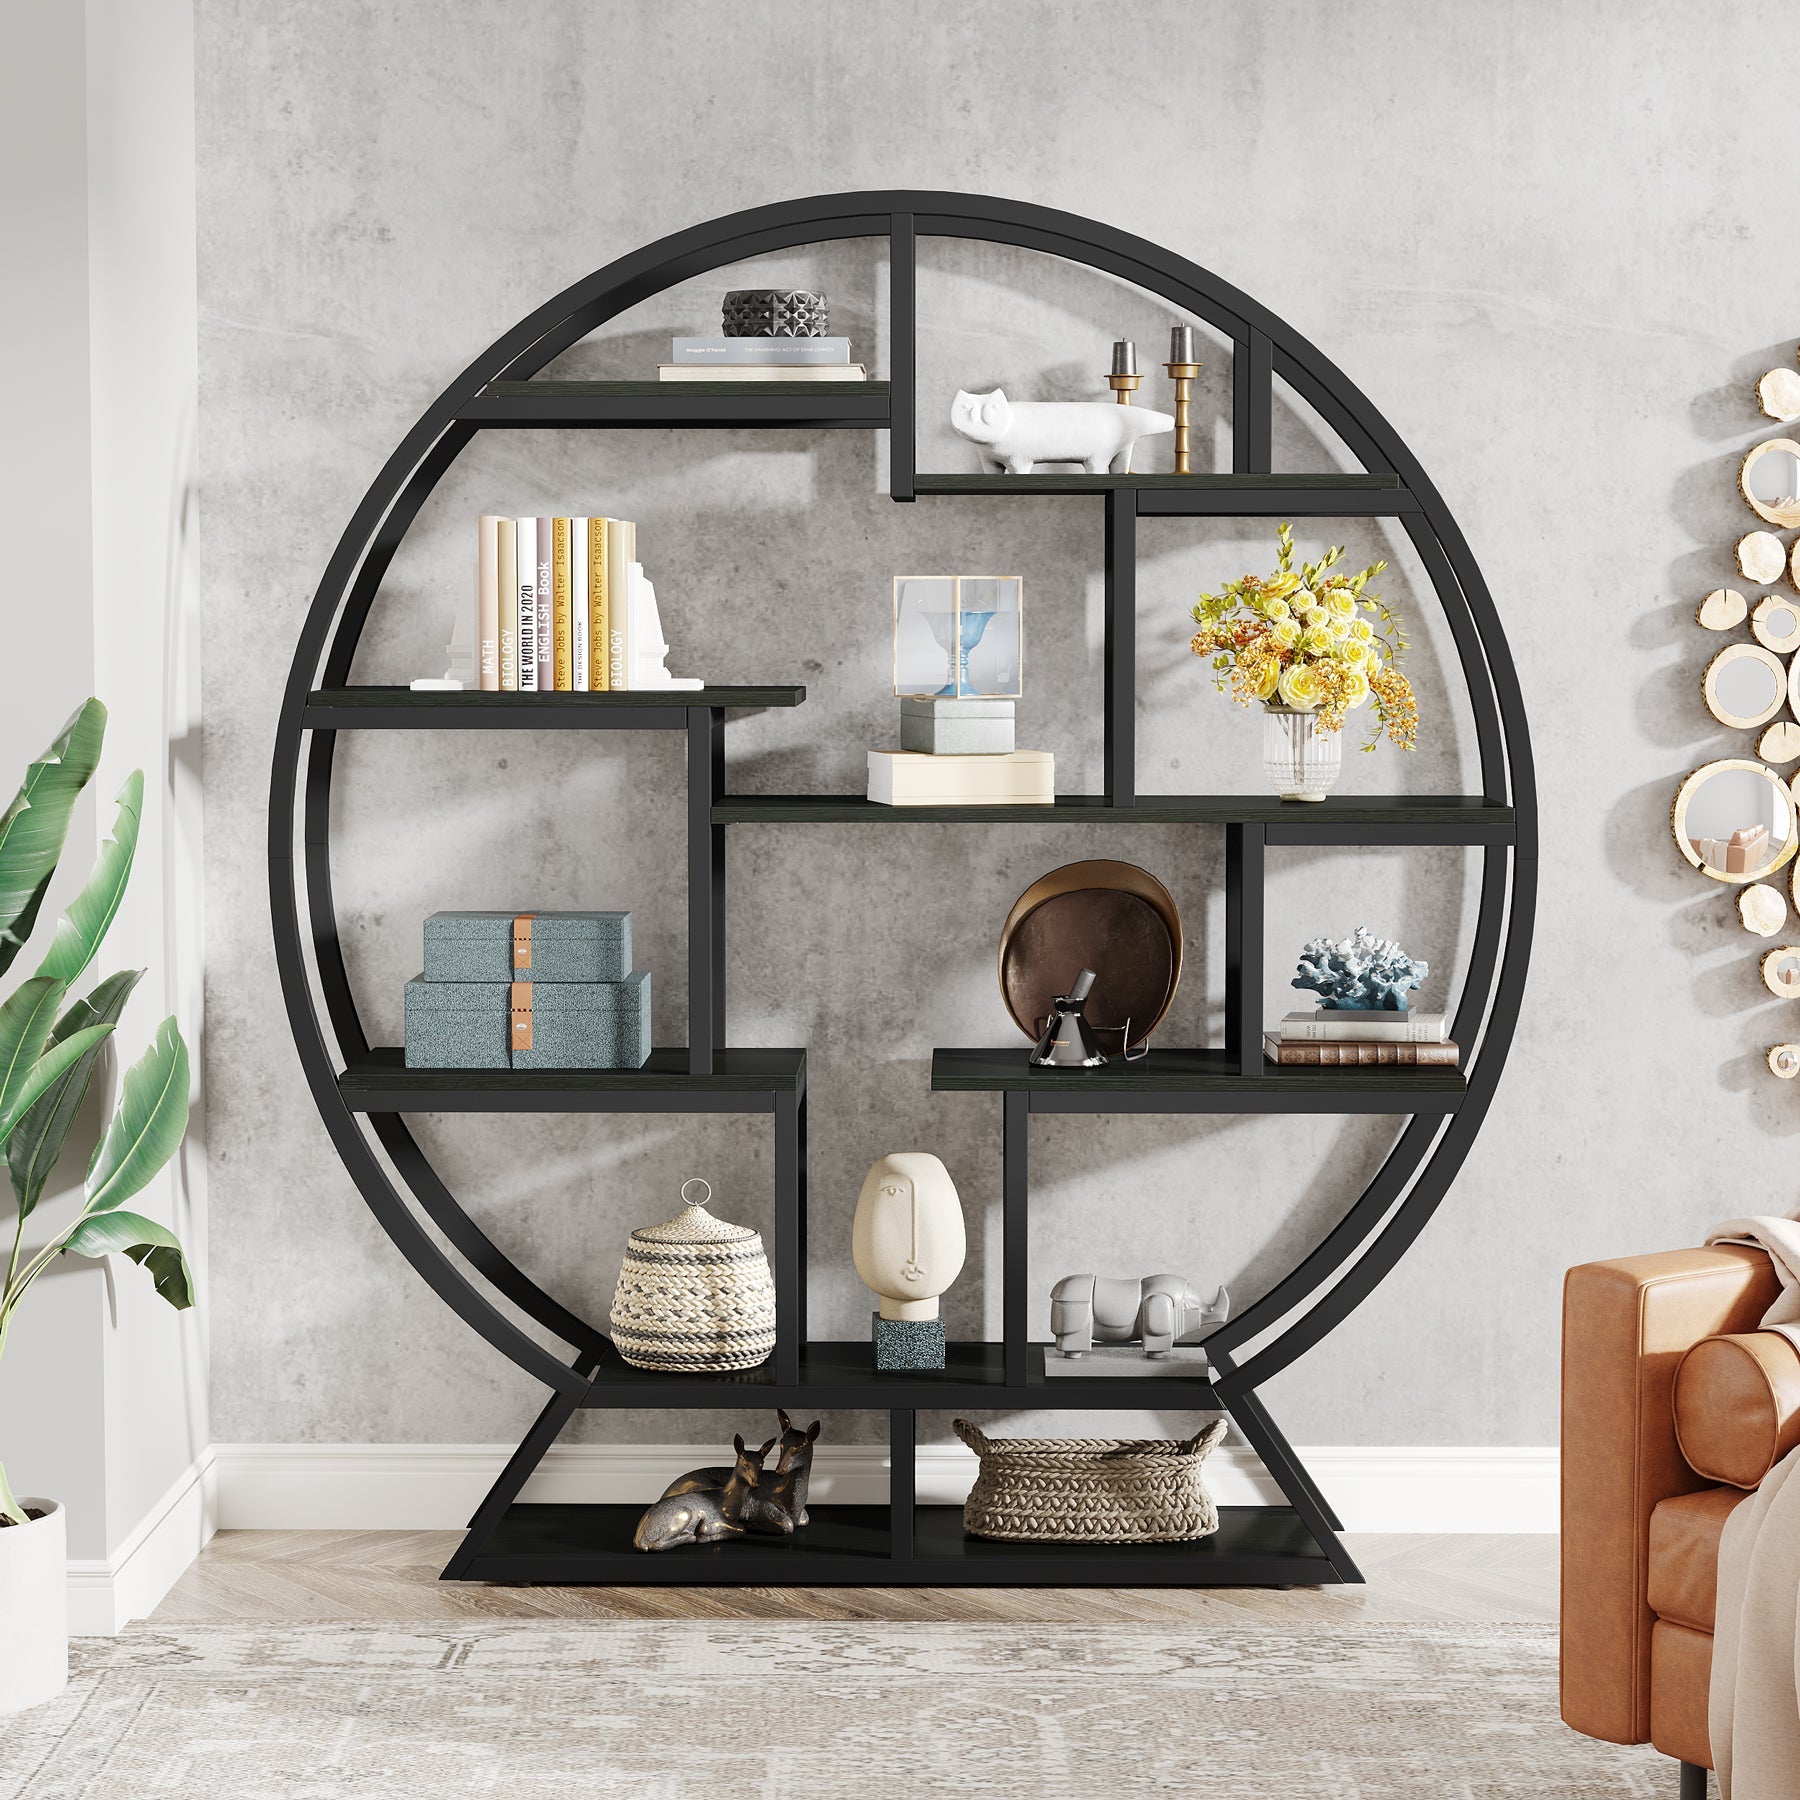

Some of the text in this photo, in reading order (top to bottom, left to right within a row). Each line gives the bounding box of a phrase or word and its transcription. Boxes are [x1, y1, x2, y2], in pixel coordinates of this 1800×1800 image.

[520, 585, 534, 688] THE WORLD IN 2020
[538, 561, 550, 662] ENGLISH Book
[556, 519, 567, 688] Steve Jobs by Walter Isaacson
[593, 519, 604, 688] Steve Jobs by Walter Isaacson
[482, 639, 495, 674] MATH
[502, 628, 514, 687] BIOLOGY
[610, 628, 623, 687] BIOLOGY
